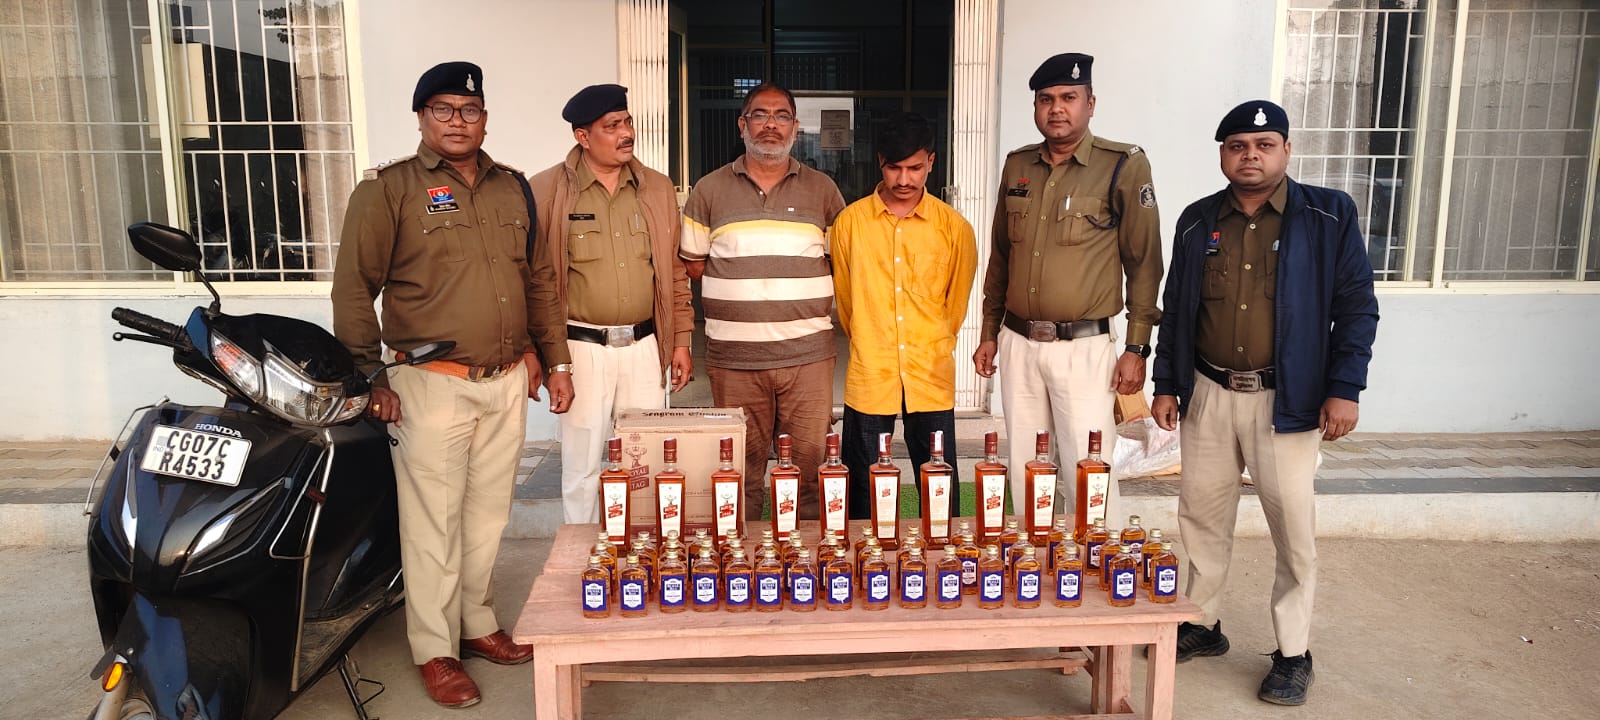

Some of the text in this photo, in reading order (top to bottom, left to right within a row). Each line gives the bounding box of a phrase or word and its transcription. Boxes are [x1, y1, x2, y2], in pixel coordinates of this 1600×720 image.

[167, 430, 231, 459] CG07C
[195, 423, 242, 438] HONDA
[159, 451, 225, 479] R4533
